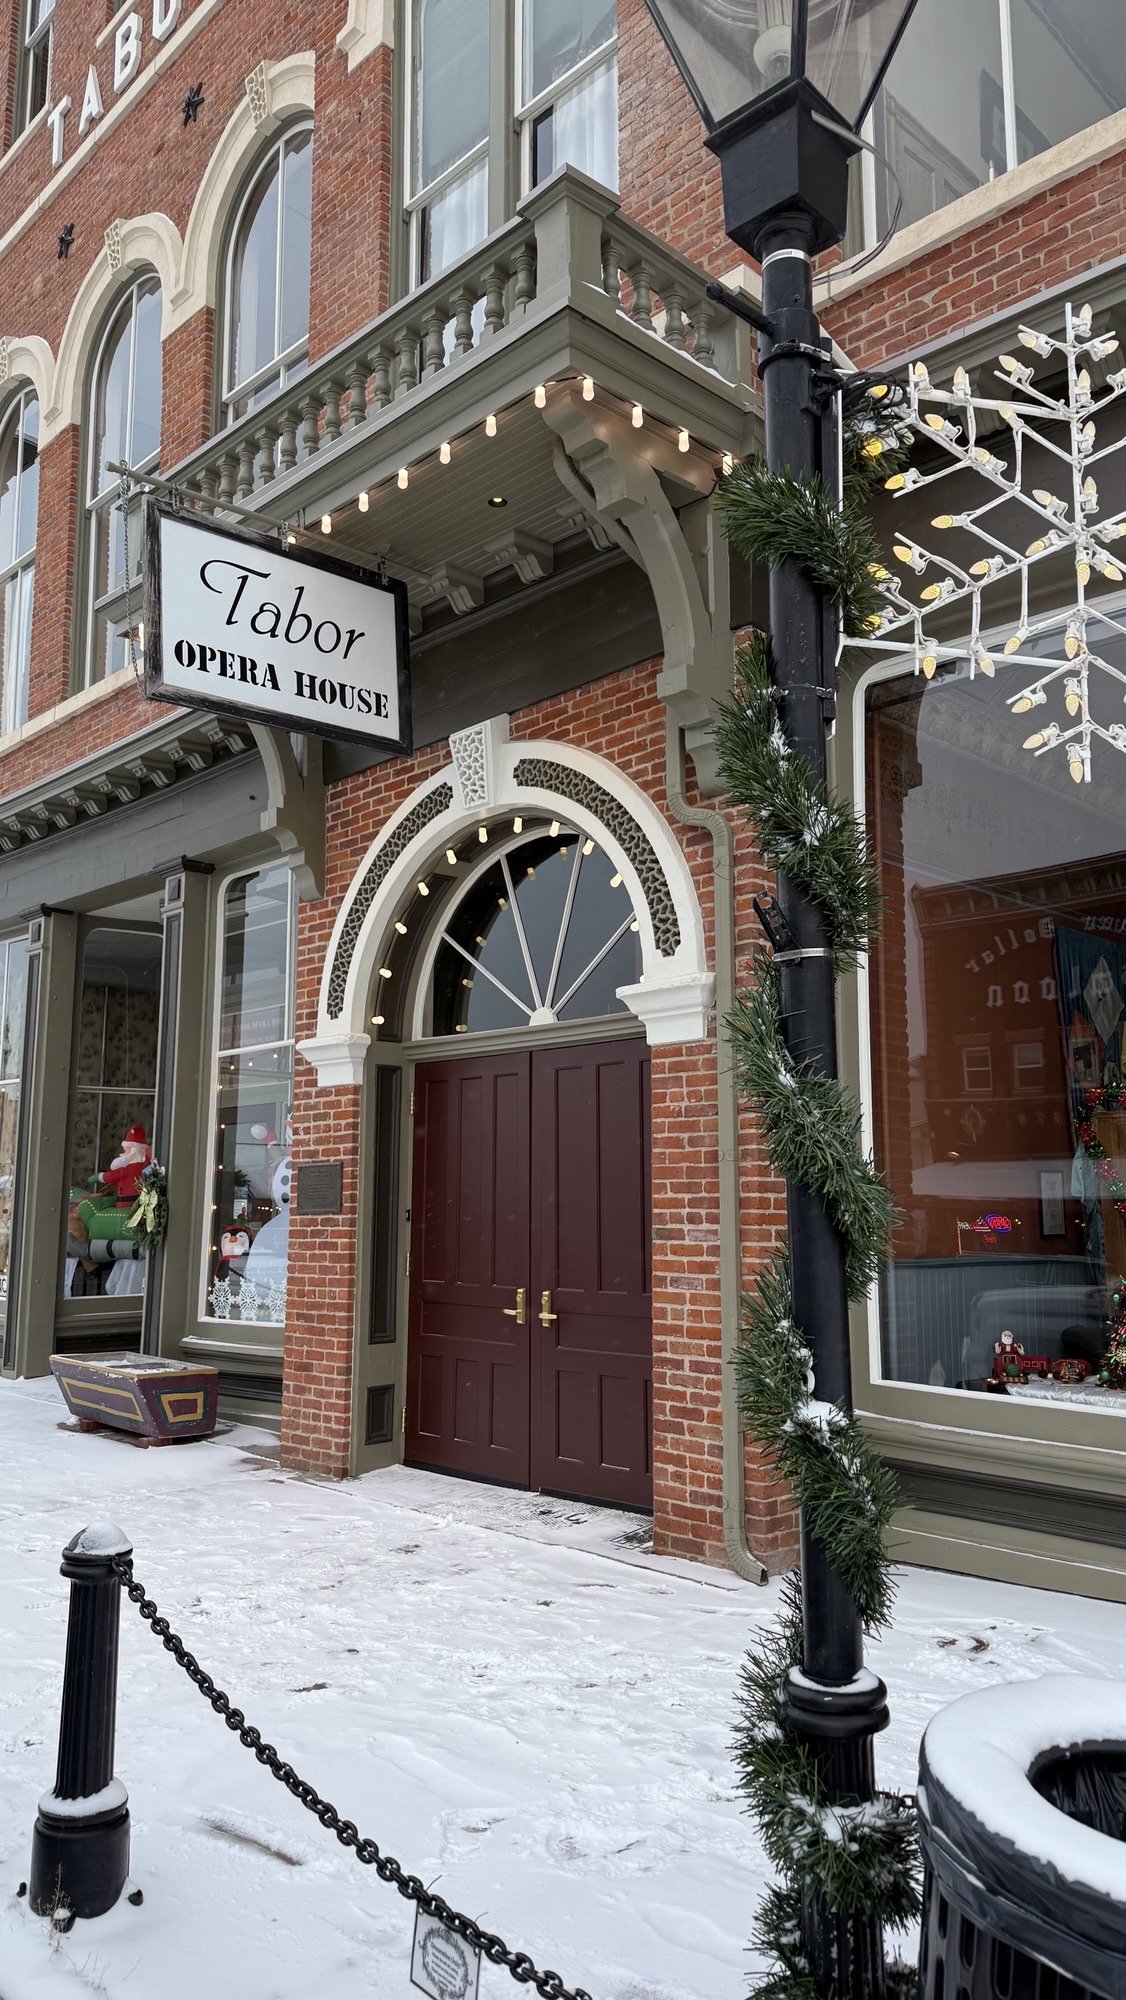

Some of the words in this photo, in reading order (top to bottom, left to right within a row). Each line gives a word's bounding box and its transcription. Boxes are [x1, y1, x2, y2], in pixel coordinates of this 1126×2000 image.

[200, 559, 365, 660] Tabor
[174, 639, 281, 692] OPERA
[294, 670, 389, 719] HOUSE
